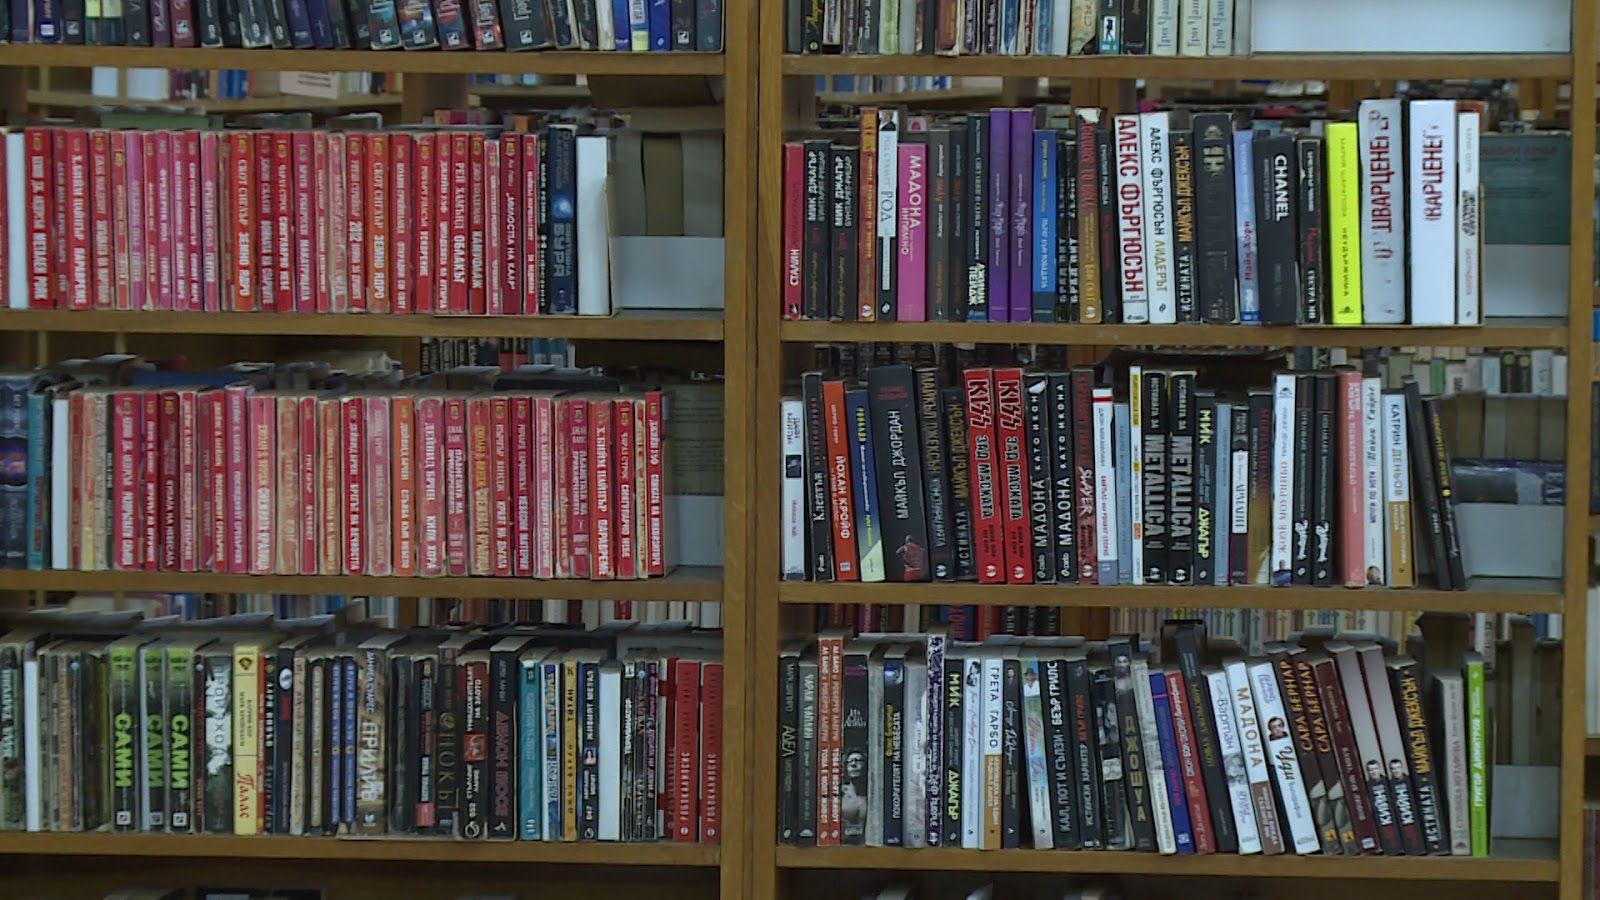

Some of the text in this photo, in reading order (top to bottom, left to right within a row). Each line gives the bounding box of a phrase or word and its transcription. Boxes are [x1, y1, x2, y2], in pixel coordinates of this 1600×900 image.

[238, 160, 248, 185] СКОТ
[374, 162, 382, 186] СКОТ
[808, 151, 818, 221] МИК ДЖАГЪР
[835, 156, 844, 226] МИК ДЖАГЪР
[908, 154, 922, 229] МАДОНА
[1274, 154, 1288, 222] CHANEL
[453, 162, 464, 283] РЕЙ ХАМЪНД ОБЛАКЪТ
[881, 191, 893, 221] РОД
[900, 208, 909, 255] ИНТИМНО
[1118, 119, 1143, 292] АЛЕКС ФЪРГЮСЪН
[1150, 128, 1167, 292] АЛЕКС ФЪРГЮСЪН ЛИДЕРЪТ
[1174, 146, 1193, 312] ИСТИНАТА МАЙКЪЛ ДЖЕКСЪН
[74, 247, 86, 304] ПАРАВРЕМЕ
[238, 233, 249, 265] ЗЕМНО
[374, 235, 384, 268] ЗЕМНО
[472, 231, 482, 288] КАМУФЛАЖ
[506, 248, 514, 260] НА
[554, 223, 564, 276] БУРЯ
[790, 249, 800, 286] СТАЛИН
[1070, 238, 1078, 263] ПИТ
[240, 270, 250, 296] ЯДРО
[374, 272, 384, 298] ЯДРО
[969, 266, 978, 305] ПЕЙДЖ
[922, 372, 934, 419] МАЙКЪЛ
[967, 379, 991, 429] KISS
[998, 379, 1022, 431] KISS
[1152, 419, 1159, 428] ЗА
[1178, 420, 1186, 430] ЗА
[1390, 404, 1400, 446] КАТРИН
[924, 422, 941, 474] ДЖЕКСЪН
[1200, 409, 1210, 445] МИК
[888, 410, 908, 518] МАЙКЪЛ ДЖОРДАН
[950, 404, 968, 566] ИСТИНАТА МАЙКЪЛ ДЖЕКСЪН
[976, 434, 994, 519] ЗАД МАСКАТА
[1004, 436, 1022, 520] ЗАД МАСКАТА
[1032, 437, 1048, 547] МАДОНА КАТО
[1056, 384, 1072, 546] МАДОНА КАТО ИКОНА
[1079, 467, 1093, 518] SLAYER
[1145, 434, 1165, 536] METALLICA
[1171, 434, 1192, 536] METALLICA
[1392, 448, 1403, 497] ДЕНЬОВ
[350, 514, 358, 524] НА
[424, 422, 436, 568] ДЕЙВИД БРИН ХОРА
[598, 470, 608, 576] ПАЙПЪР ПАРАВРЕМЕ
[836, 456, 850, 539] ЙОХАН КРОЙФ
[166, 526, 174, 565] НЕБЕСАТА
[497, 528, 506, 538] НА
[1198, 507, 1210, 559] ДЖАГЪР
[586, 670, 594, 700] МЕТАЛ
[804, 674, 813, 739] ЧАРЛИ ЧАПЛИН
[990, 667, 998, 748] ГРЕТА ГАРБО
[1046, 662, 1062, 725] БЕЪР ГРИЛС
[1279, 660, 1313, 752] САРА БЕРНАР
[1297, 662, 1331, 753] САРА БЕРНАР
[115, 714, 132, 787] САМИ
[147, 714, 162, 787] САМИ
[171, 714, 188, 788] САМИ
[624, 698, 632, 755] ТЕРМИНАТОР
[782, 724, 795, 756] АДЕЛ
[948, 673, 960, 820] МИК ДЖАГЪР
[1055, 734, 1066, 770] СЪЛЗИ
[1190, 682, 1215, 767] НОВАК ДЖОКОВИЧ
[1216, 699, 1234, 750] Вартан
[1236, 688, 1263, 768] МАДОНА
[362, 722, 378, 802] ПРИЛИВ
[680, 752, 690, 820] РОБОКАЛИПСИС
[708, 753, 716, 822] РОБОКАЛИПСИС
[892, 712, 902, 818] ПОКОРИТЕЛЯТ НА НЕБЕСАТА
[1080, 744, 1094, 826] ИСТИНСКИ ХАРАКТЕР
[1124, 715, 1147, 822] ДЖОШУА
[1402, 676, 1438, 842] ИСТИНАТА МАЙКЪЛ ДЖЕКСЪН
[1472, 718, 1483, 807] ГРИГОР ДИМИТРОВ
[236, 772, 254, 818] Палас
[930, 798, 938, 826] PURPLE
[1058, 783, 1069, 804] ПОТ
[1059, 806, 1070, 831] КАЛ,
